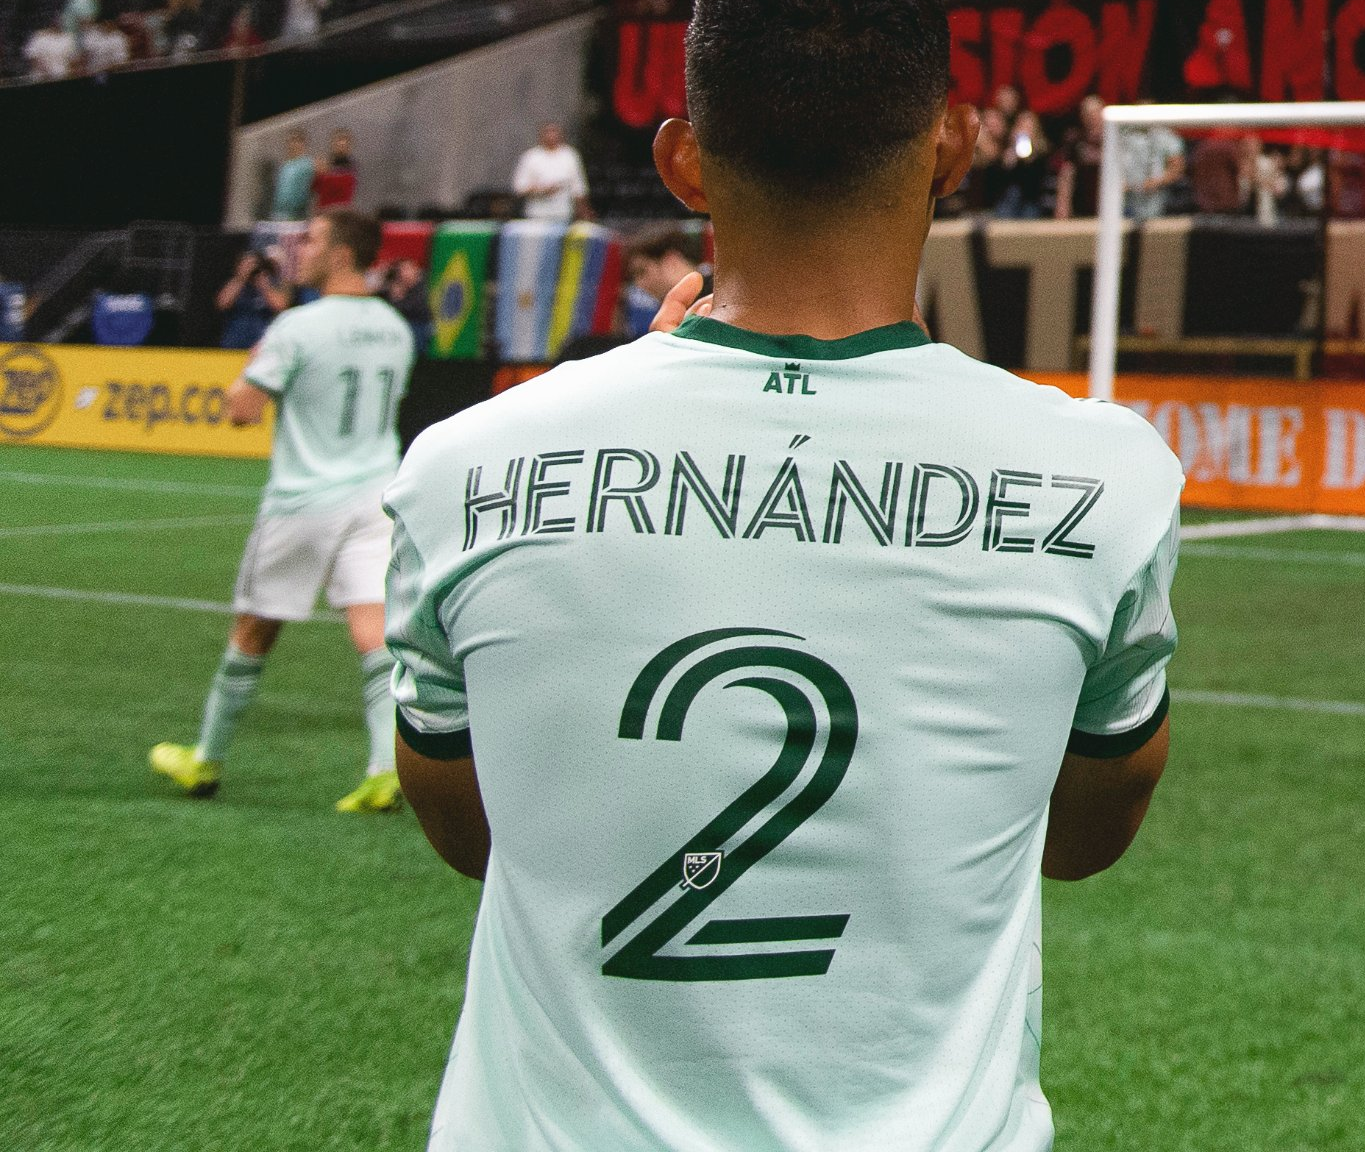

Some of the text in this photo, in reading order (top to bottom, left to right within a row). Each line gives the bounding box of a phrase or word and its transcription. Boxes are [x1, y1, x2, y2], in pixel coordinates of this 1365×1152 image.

[103, 379, 228, 432] zep.co
[338, 366, 395, 437] 11
[762, 371, 818, 396] ATL
[462, 433, 1106, 560] HERNÁNDEZ
[601, 626, 859, 982] 2
[687, 855, 707, 865] MLS
